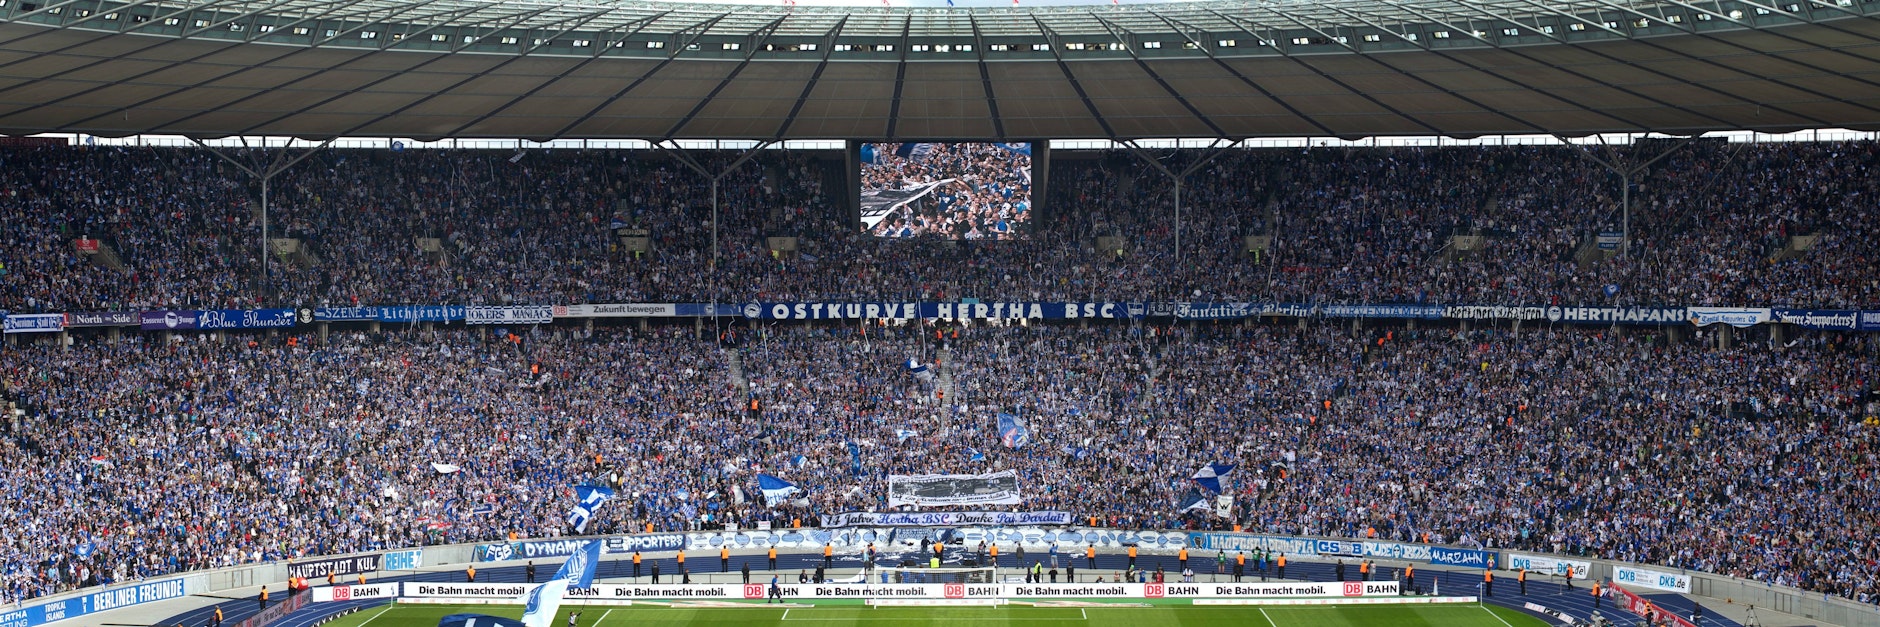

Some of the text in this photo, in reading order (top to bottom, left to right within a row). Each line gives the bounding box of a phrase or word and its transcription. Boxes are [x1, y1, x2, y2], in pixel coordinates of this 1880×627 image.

[325, 307, 362, 318] SZENE
[467, 307, 552, 320] JOKERS MANIACS
[593, 305, 626, 314] Zukunft
[627, 305, 665, 316] bewegen
[772, 303, 1115, 319] OSTKURVE HERTHA BSC
[1177, 302, 1248, 318] Fanatics
[1564, 307, 1684, 322] HERTHAFANS
[76, 313, 131, 324] North Side
[207, 310, 291, 328] Blue Thunder
[1805, 312, 1851, 329] Supporters
[844, 513, 875, 527] Jahre
[877, 513, 919, 524] Hertha
[956, 512, 993, 524] Danke
[486, 544, 511, 561] FGB
[1318, 541, 1340, 553] GS
[1363, 542, 1393, 557] RUDE
[385, 551, 414, 571] REIHE
[1431, 548, 1484, 565] MARZAHN
[288, 559, 353, 578] HAUPTSTADT
[1513, 558, 1531, 570] DKB
[1619, 570, 1635, 582] DKB
[1659, 575, 1686, 589] DKB.de
[335, 587, 380, 599] DB BAHN
[419, 586, 435, 595] Die
[437, 585, 463, 595] Bahn
[465, 585, 495, 595] macht
[569, 587, 599, 596] BAHN
[615, 588, 726, 596] Die Bahn macht mobil.
[746, 586, 762, 596] DB
[815, 587, 927, 596] Die Bahn macht mobil.
[946, 586, 999, 596] DB BAHN
[1016, 587, 1127, 596] Die Bahn macht mobil.
[1146, 585, 1199, 595] DB BAHN
[1216, 585, 1326, 595] Die Bahn macht mobil.
[1345, 584, 1397, 594] DB BAHN
[93, 589, 137, 612] BERLINER
[139, 579, 183, 602] FREUNDE
[45, 601, 67, 613] TROPICAL
[45, 610, 66, 622] ISLANDS
